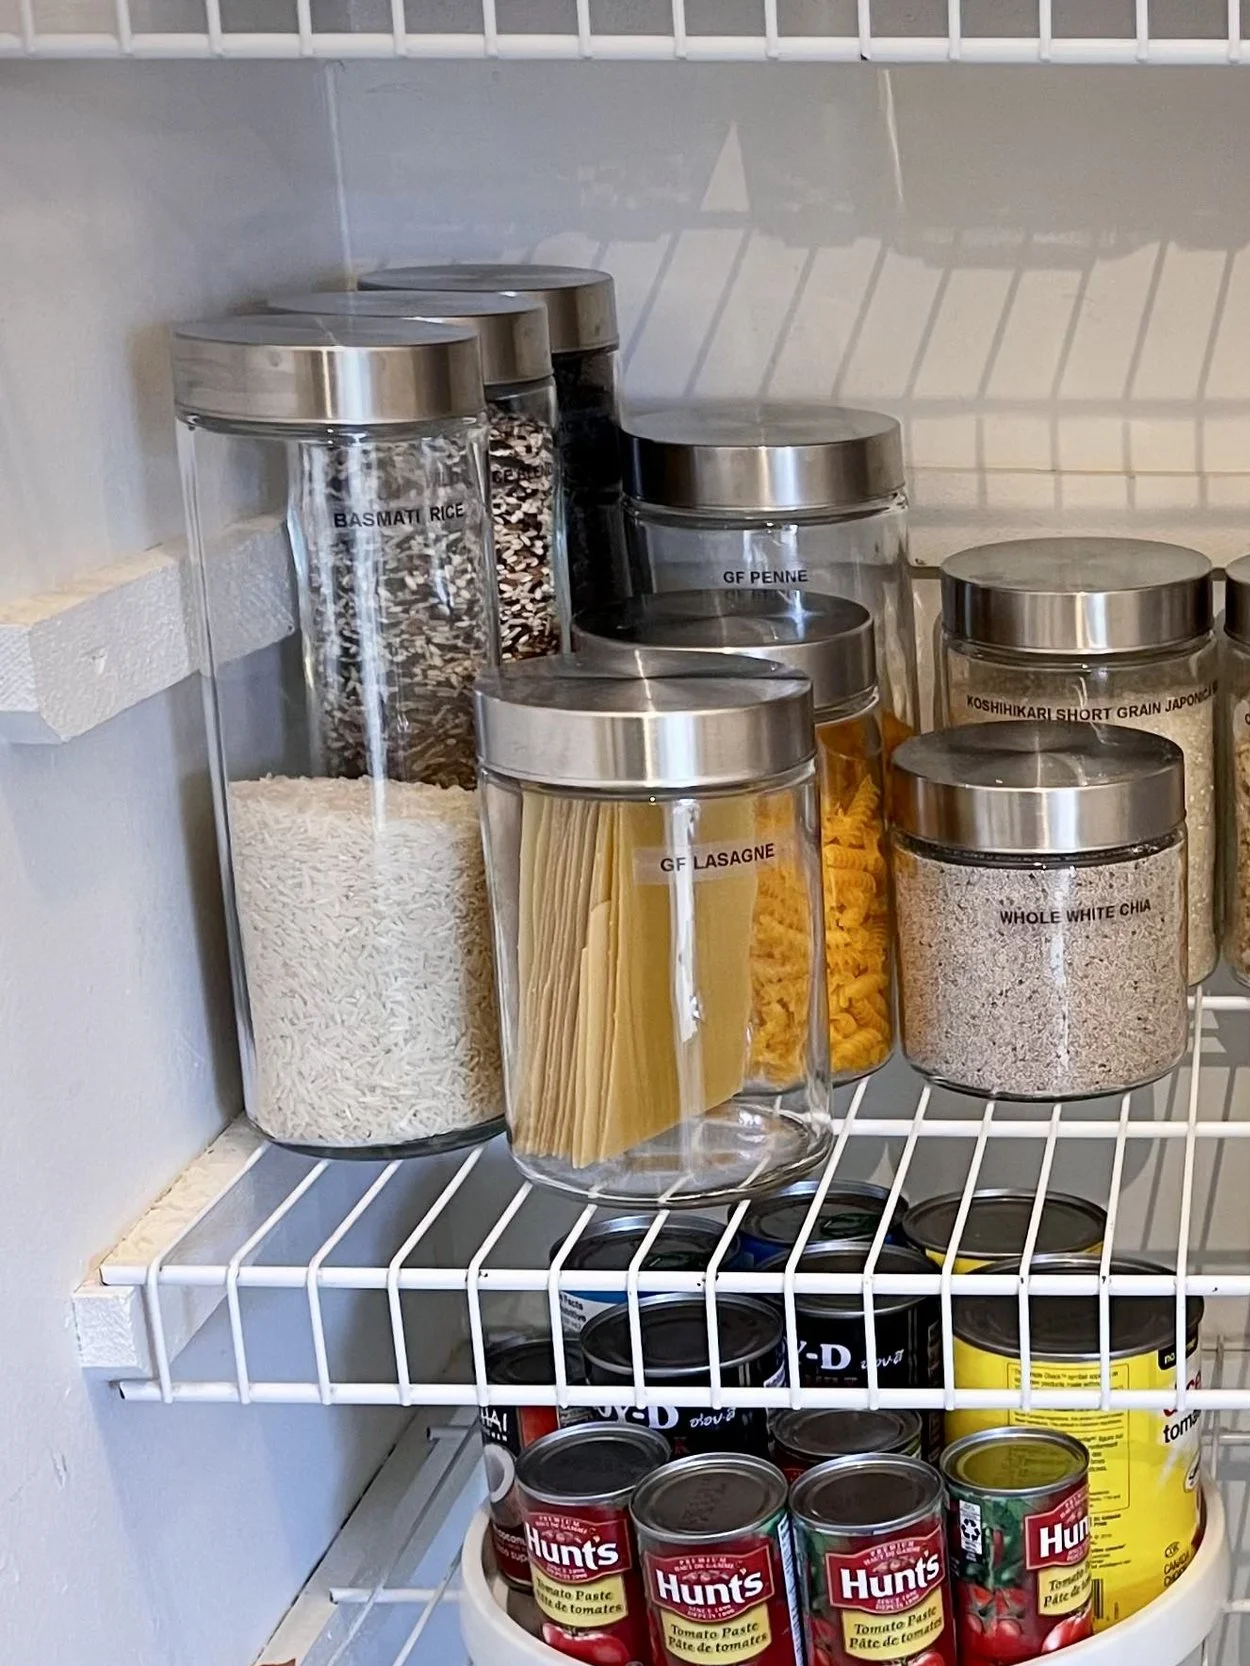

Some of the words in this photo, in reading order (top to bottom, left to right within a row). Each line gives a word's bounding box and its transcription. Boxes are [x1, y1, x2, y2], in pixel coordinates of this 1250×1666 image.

[334, 510, 421, 528] BASMATI
[430, 502, 465, 522] RICE
[723, 571, 744, 584] GF
[750, 569, 809, 584] PENNE
[967, 695, 1051, 721] KOSHIHIKARI
[1056, 708, 1111, 721] SHORT
[1116, 702, 1161, 720] GRAIN
[660, 857, 686, 872] GF
[693, 843, 775, 870] LASAGNE
[1000, 911, 1062, 925] WHOLE
[1067, 905, 1116, 923] WHITE
[1119, 899, 1151, 916] CHIA
[523, 1522, 619, 1571] Hunt's
[655, 1568, 764, 1606] Hunt's
[840, 1550, 940, 1600] Hunt's
[1049, 1569, 1084, 1592] Tomato
[555, 1600, 568, 1612] de
[570, 1603, 623, 1616] tomates
[575, 1590, 613, 1602] Paste
[1043, 1592, 1069, 1608] Pâte
[671, 1624, 718, 1640] Tomato
[722, 1622, 759, 1637] Paste
[854, 1620, 905, 1636] Tomato
[907, 1605, 937, 1627] Paste
[668, 1635, 695, 1653] Pâte
[696, 1640, 711, 1653] de
[715, 1633, 767, 1652] tomates
[849, 1636, 881, 1651] Pâte
[882, 1635, 900, 1648] de
[901, 1618, 943, 1645] tomates
